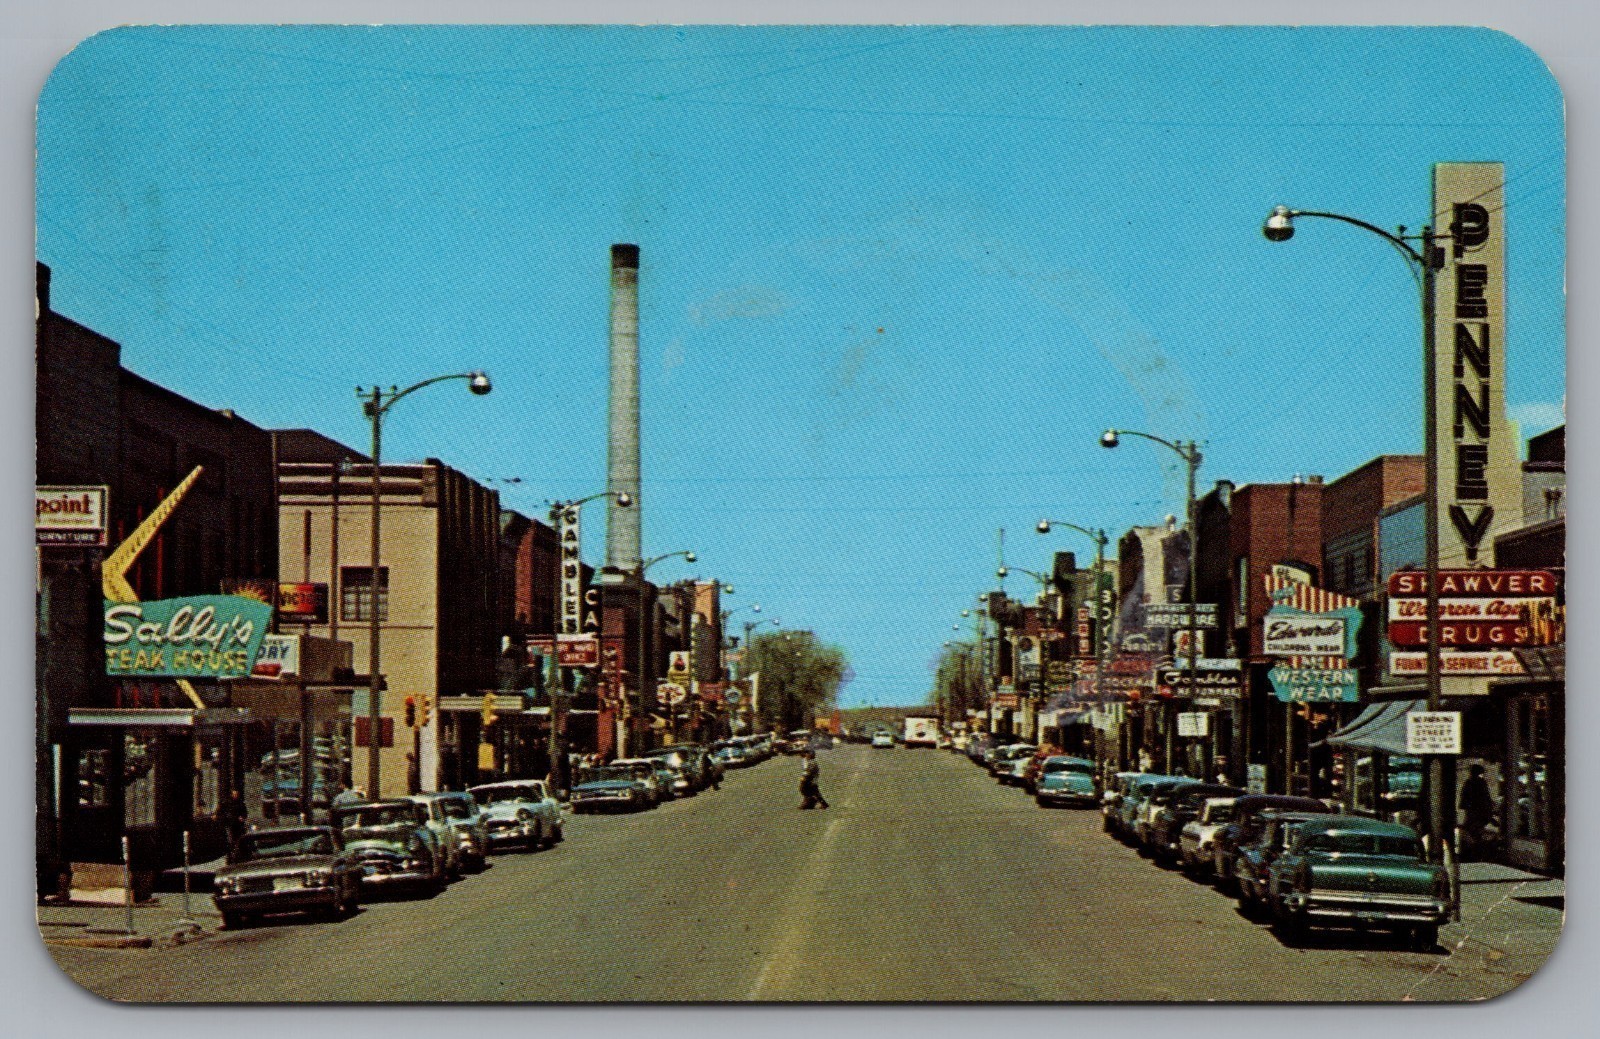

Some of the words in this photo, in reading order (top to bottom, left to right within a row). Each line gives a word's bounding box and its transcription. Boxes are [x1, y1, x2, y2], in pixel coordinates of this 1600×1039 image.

[1449, 203, 1494, 562] PENNEY
[37, 494, 93, 517] point
[564, 510, 577, 632] GAMBLES
[1397, 601, 1481, 618] Wagreen
[104, 604, 253, 653] Sally's
[172, 649, 248, 670] HOUSE
[1446, 657, 1489, 671] SERVICE
[1273, 670, 1355, 684] WESTERN
[1290, 687, 1343, 699] WEAR
